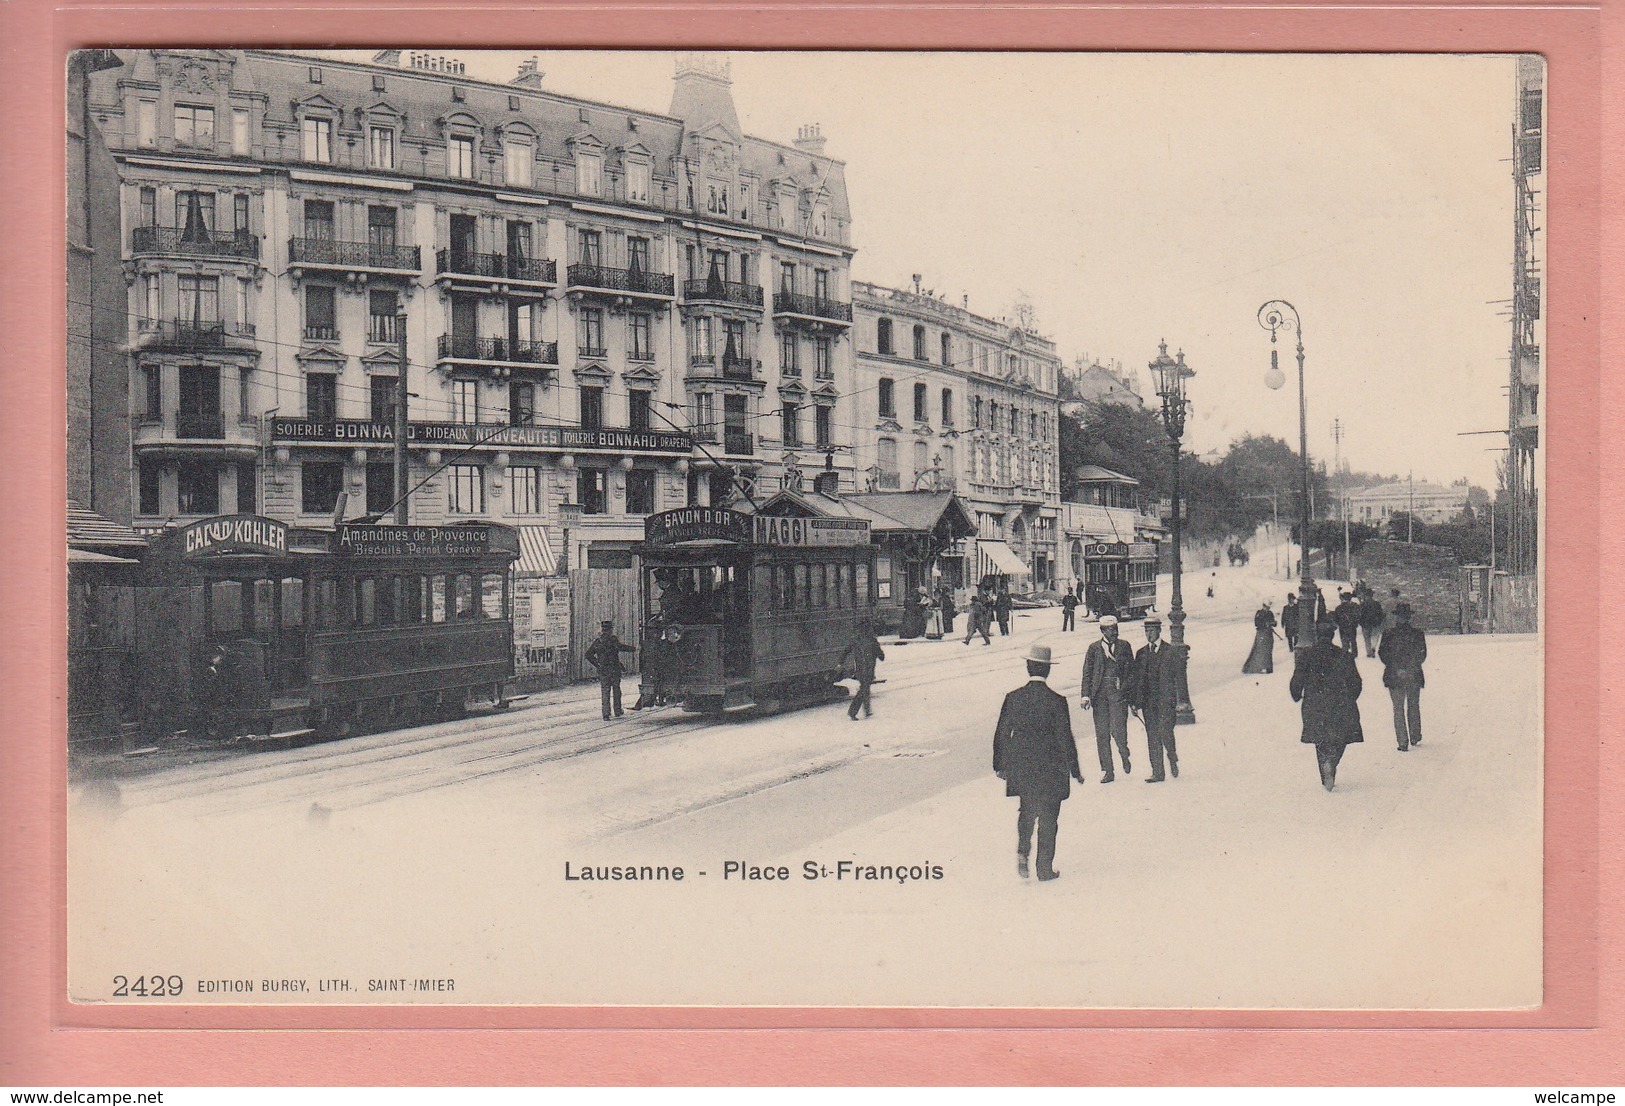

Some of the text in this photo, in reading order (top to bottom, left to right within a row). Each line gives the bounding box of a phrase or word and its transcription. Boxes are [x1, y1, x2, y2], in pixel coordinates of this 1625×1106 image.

[276, 423, 692, 449] SOIERIE BONNAD RIDEAUX NOUVEAUTES TOILERIE BONNARD DRAPERIE
[665, 510, 700, 528] SAVON
[234, 520, 285, 551] KOHLER
[341, 526, 487, 546] Amandines de Provence
[756, 517, 808, 545] MAGGI
[354, 543, 401, 556] Biscuits
[565, 861, 685, 881] Lausanne
[723, 861, 790, 881] Place
[802, 860, 945, 885] St-François
[112, 974, 184, 997] 2429
[198, 979, 254, 992] EDITION
[262, 979, 310, 994] BURGY,
